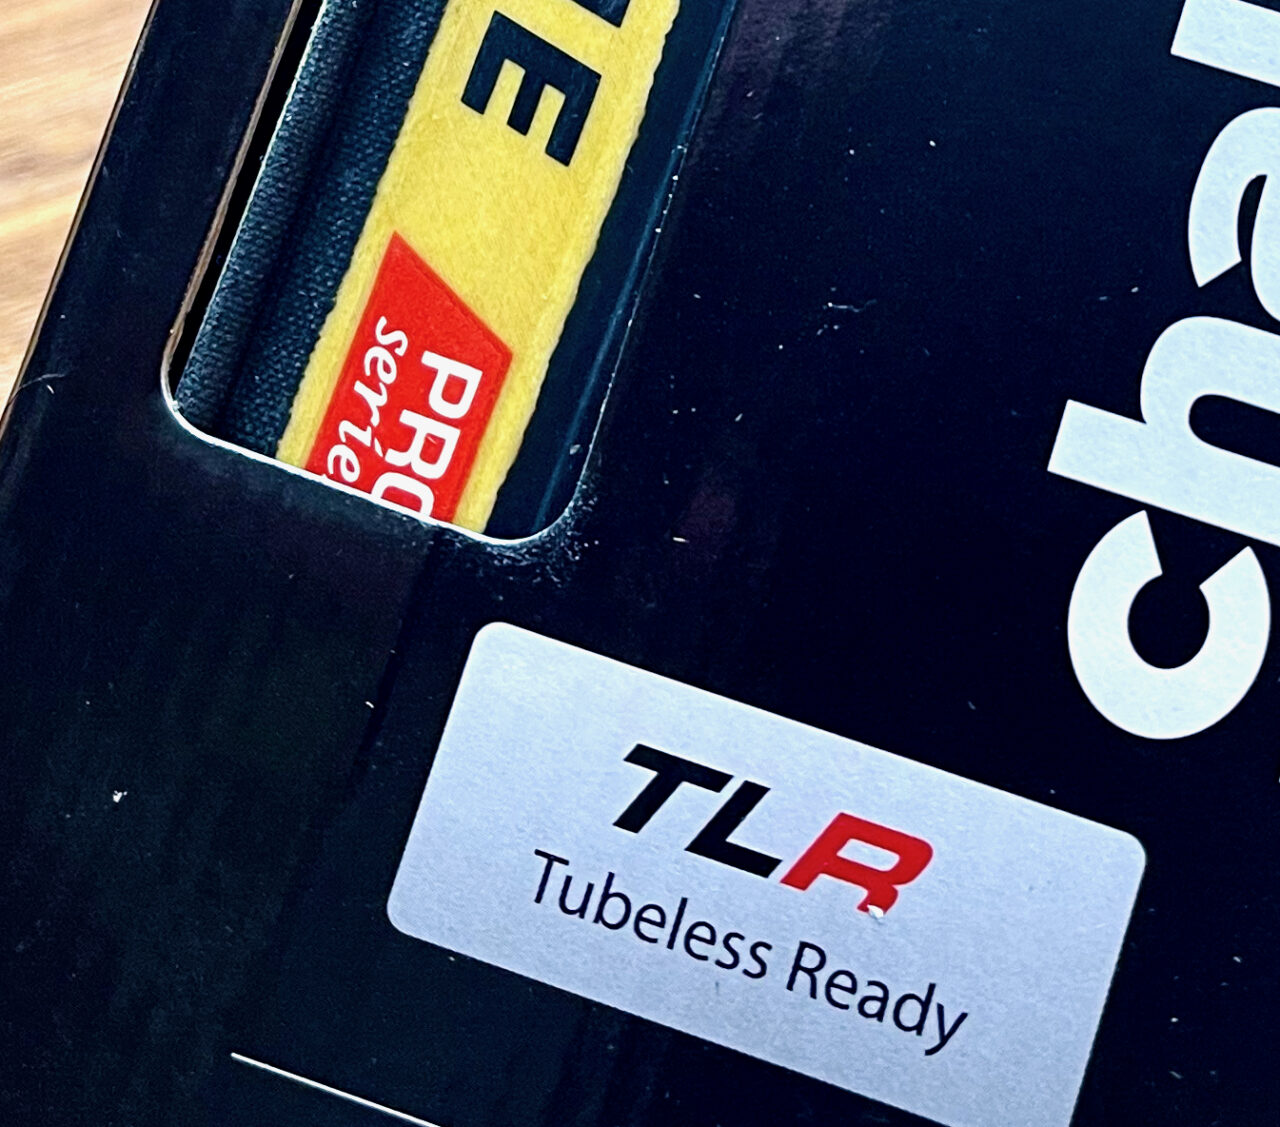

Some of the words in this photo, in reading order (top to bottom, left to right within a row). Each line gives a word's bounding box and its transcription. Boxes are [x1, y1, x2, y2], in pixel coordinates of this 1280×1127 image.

[325, 316, 408, 484] serie
[612, 743, 934, 918] TLR
[533, 848, 772, 980] Tubeless
[786, 941, 969, 1056] Ready
